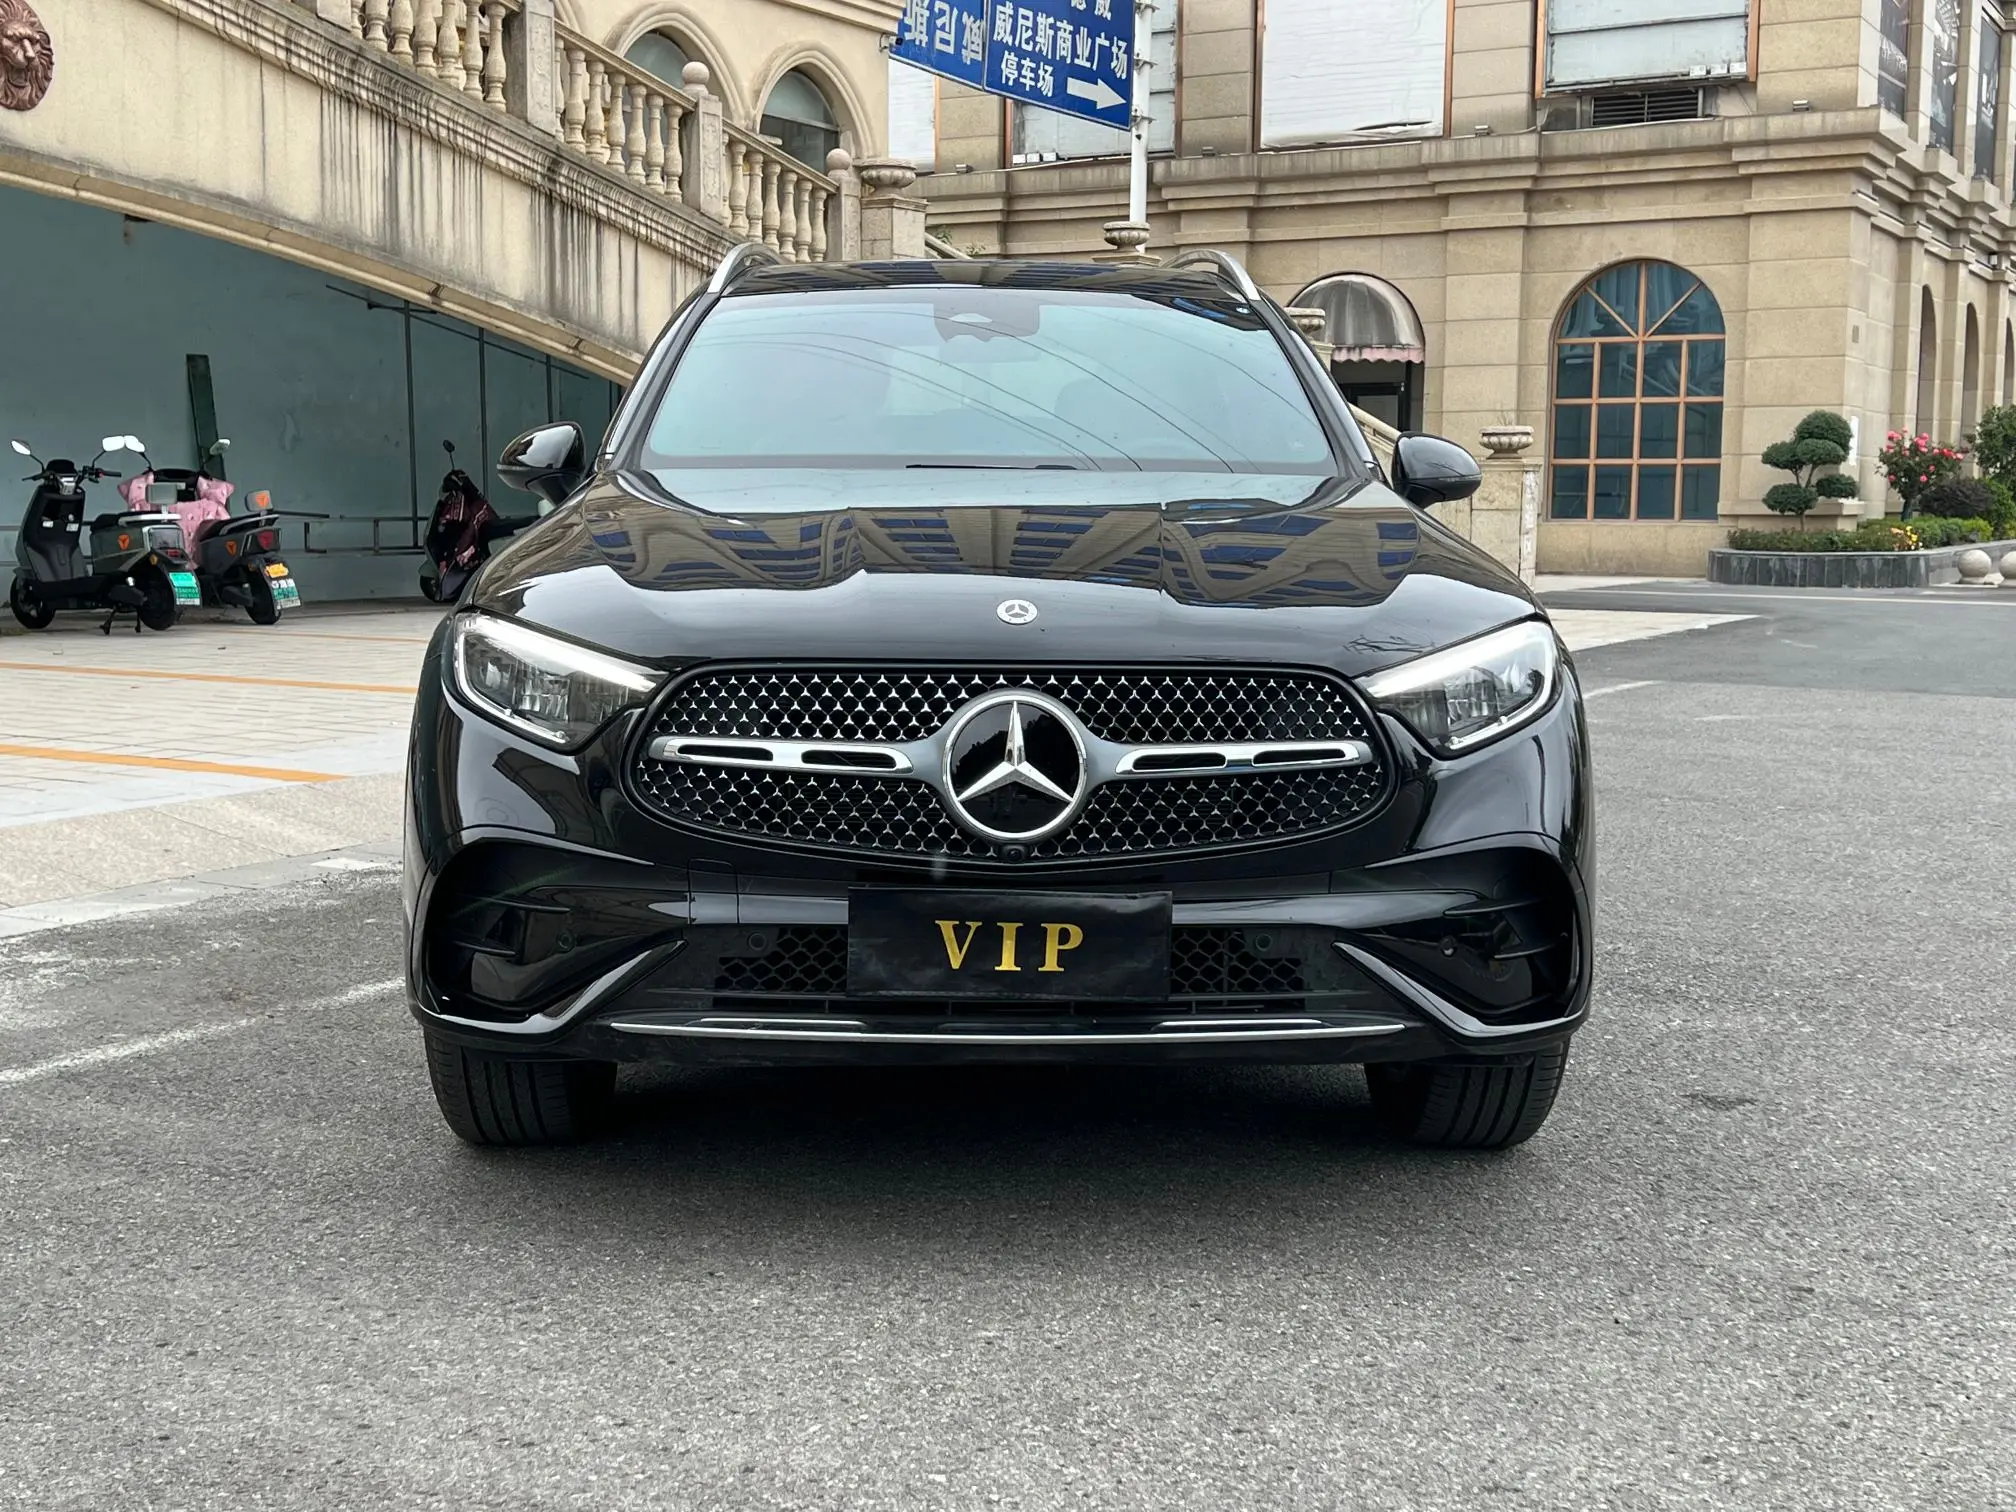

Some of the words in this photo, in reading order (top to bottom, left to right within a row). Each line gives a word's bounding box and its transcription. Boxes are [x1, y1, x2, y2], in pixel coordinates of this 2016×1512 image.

[993, 4, 1128, 79] 威尼斯商业广场
[1001, 51, 1054, 97] 停车场
[935, 920, 1083, 971] VIP
